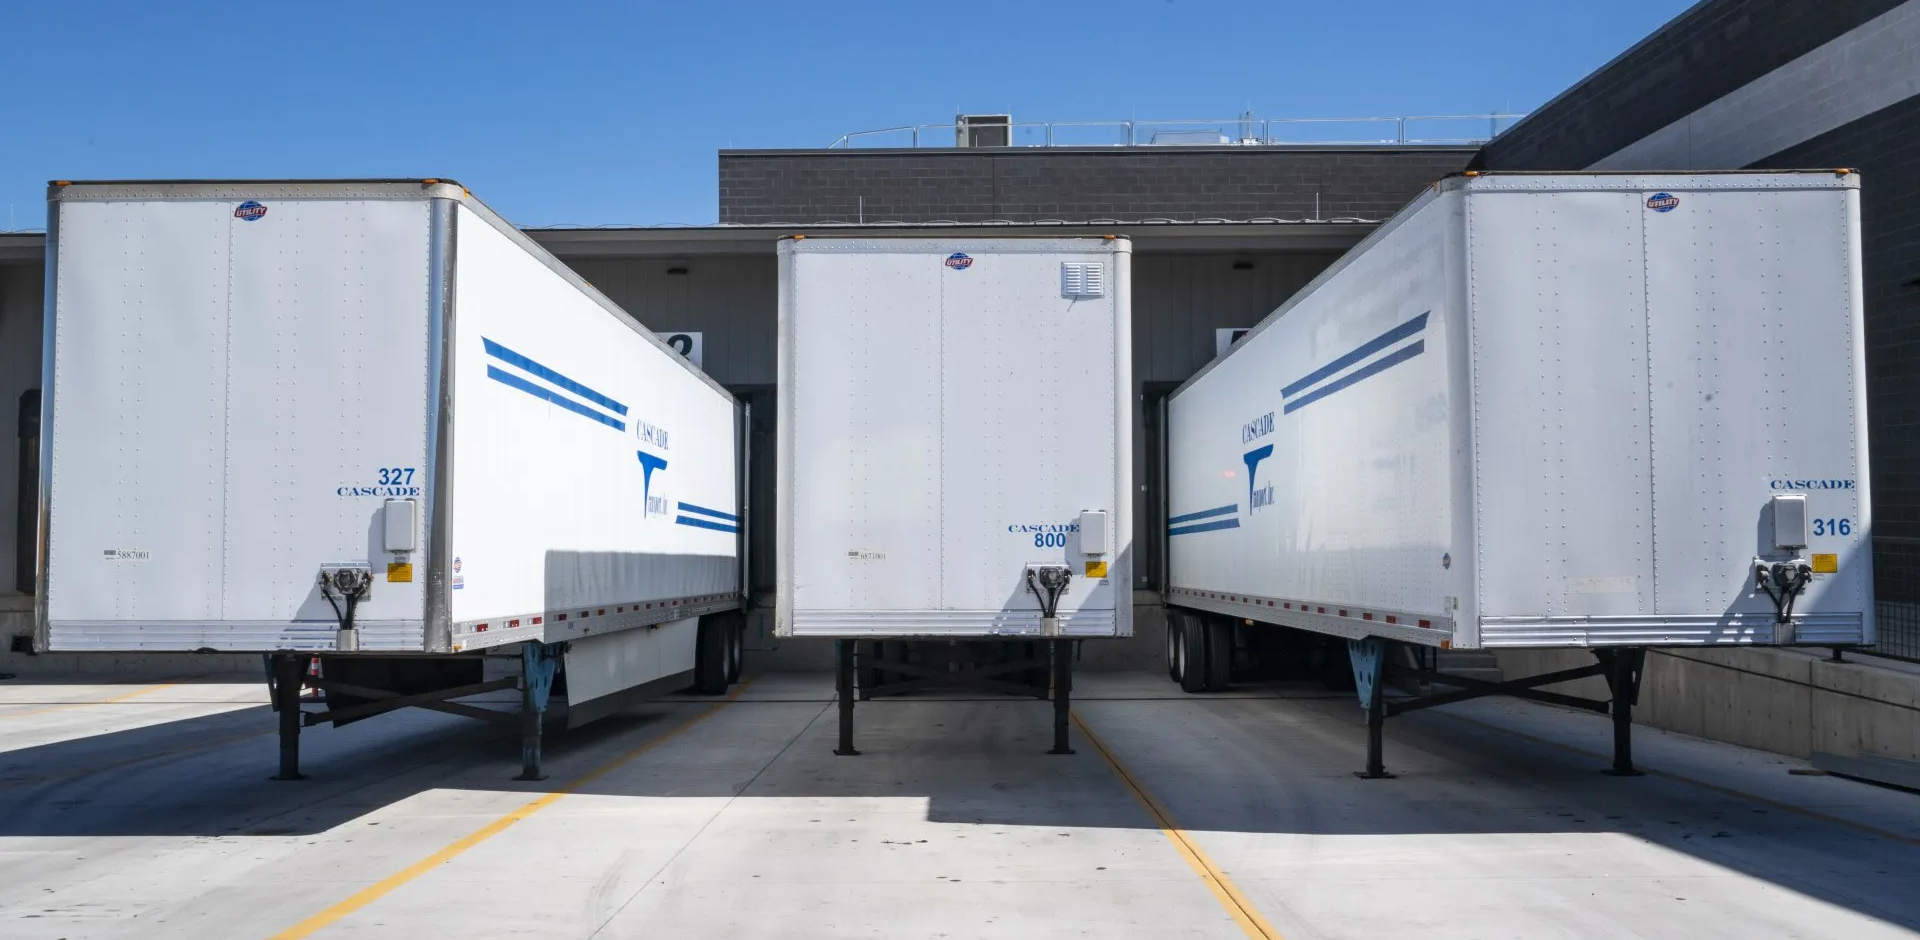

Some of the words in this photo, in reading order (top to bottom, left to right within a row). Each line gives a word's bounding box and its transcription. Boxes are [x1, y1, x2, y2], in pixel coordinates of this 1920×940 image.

[1648, 199, 1678, 207] UTILITY
[236, 207, 266, 216] UTILITY
[946, 258, 972, 266] UTILITY
[1242, 412, 1275, 444] CASCADE
[636, 419, 669, 450] CASCADE
[378, 467, 415, 486] 327
[1770, 479, 1855, 490] CASCADE
[337, 486, 420, 497] CASCADE
[1008, 523, 1080, 533] CASCADE
[1812, 518, 1851, 537] 316
[1034, 532, 1066, 548] 800
[116, 550, 150, 560] 5887001
